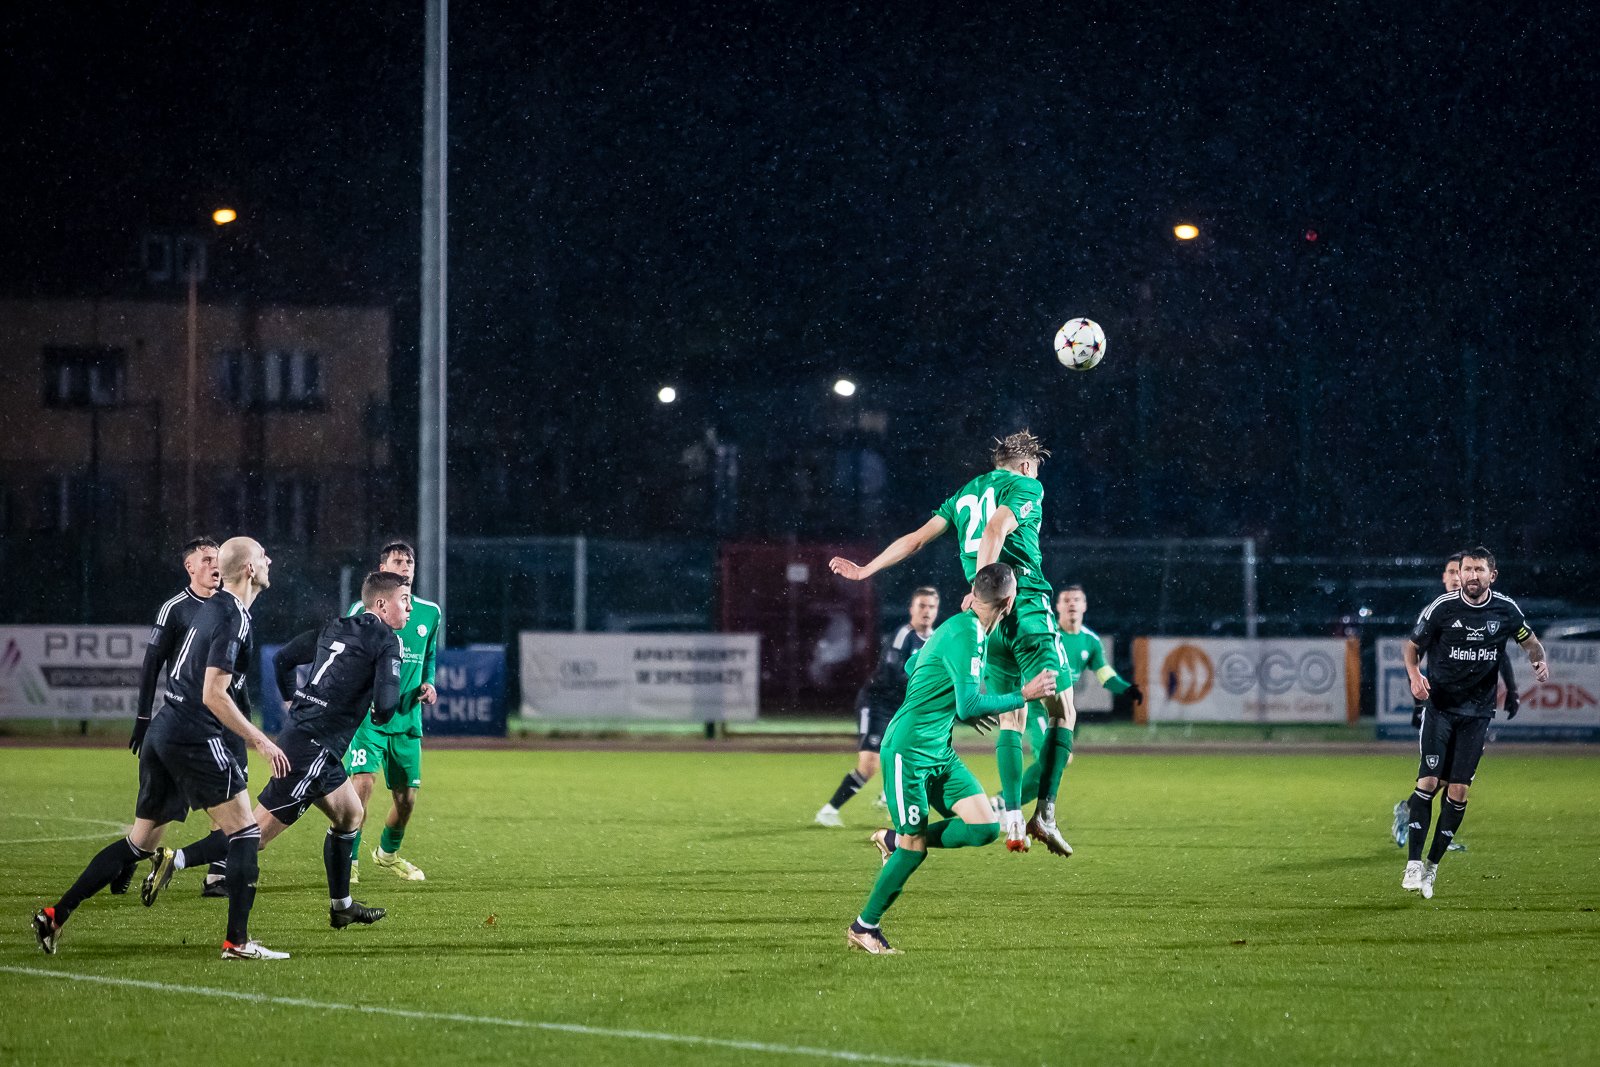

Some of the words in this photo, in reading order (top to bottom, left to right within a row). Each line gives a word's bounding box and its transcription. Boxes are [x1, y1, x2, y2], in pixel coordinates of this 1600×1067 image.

[311, 641, 346, 686] 7
[1449, 646, 1477, 661] Jelenia
[1477, 648, 1498, 661] Plast
[1217, 650, 1337, 696] eco
[351, 748, 367, 767] 28
[908, 804, 921, 826] 8
